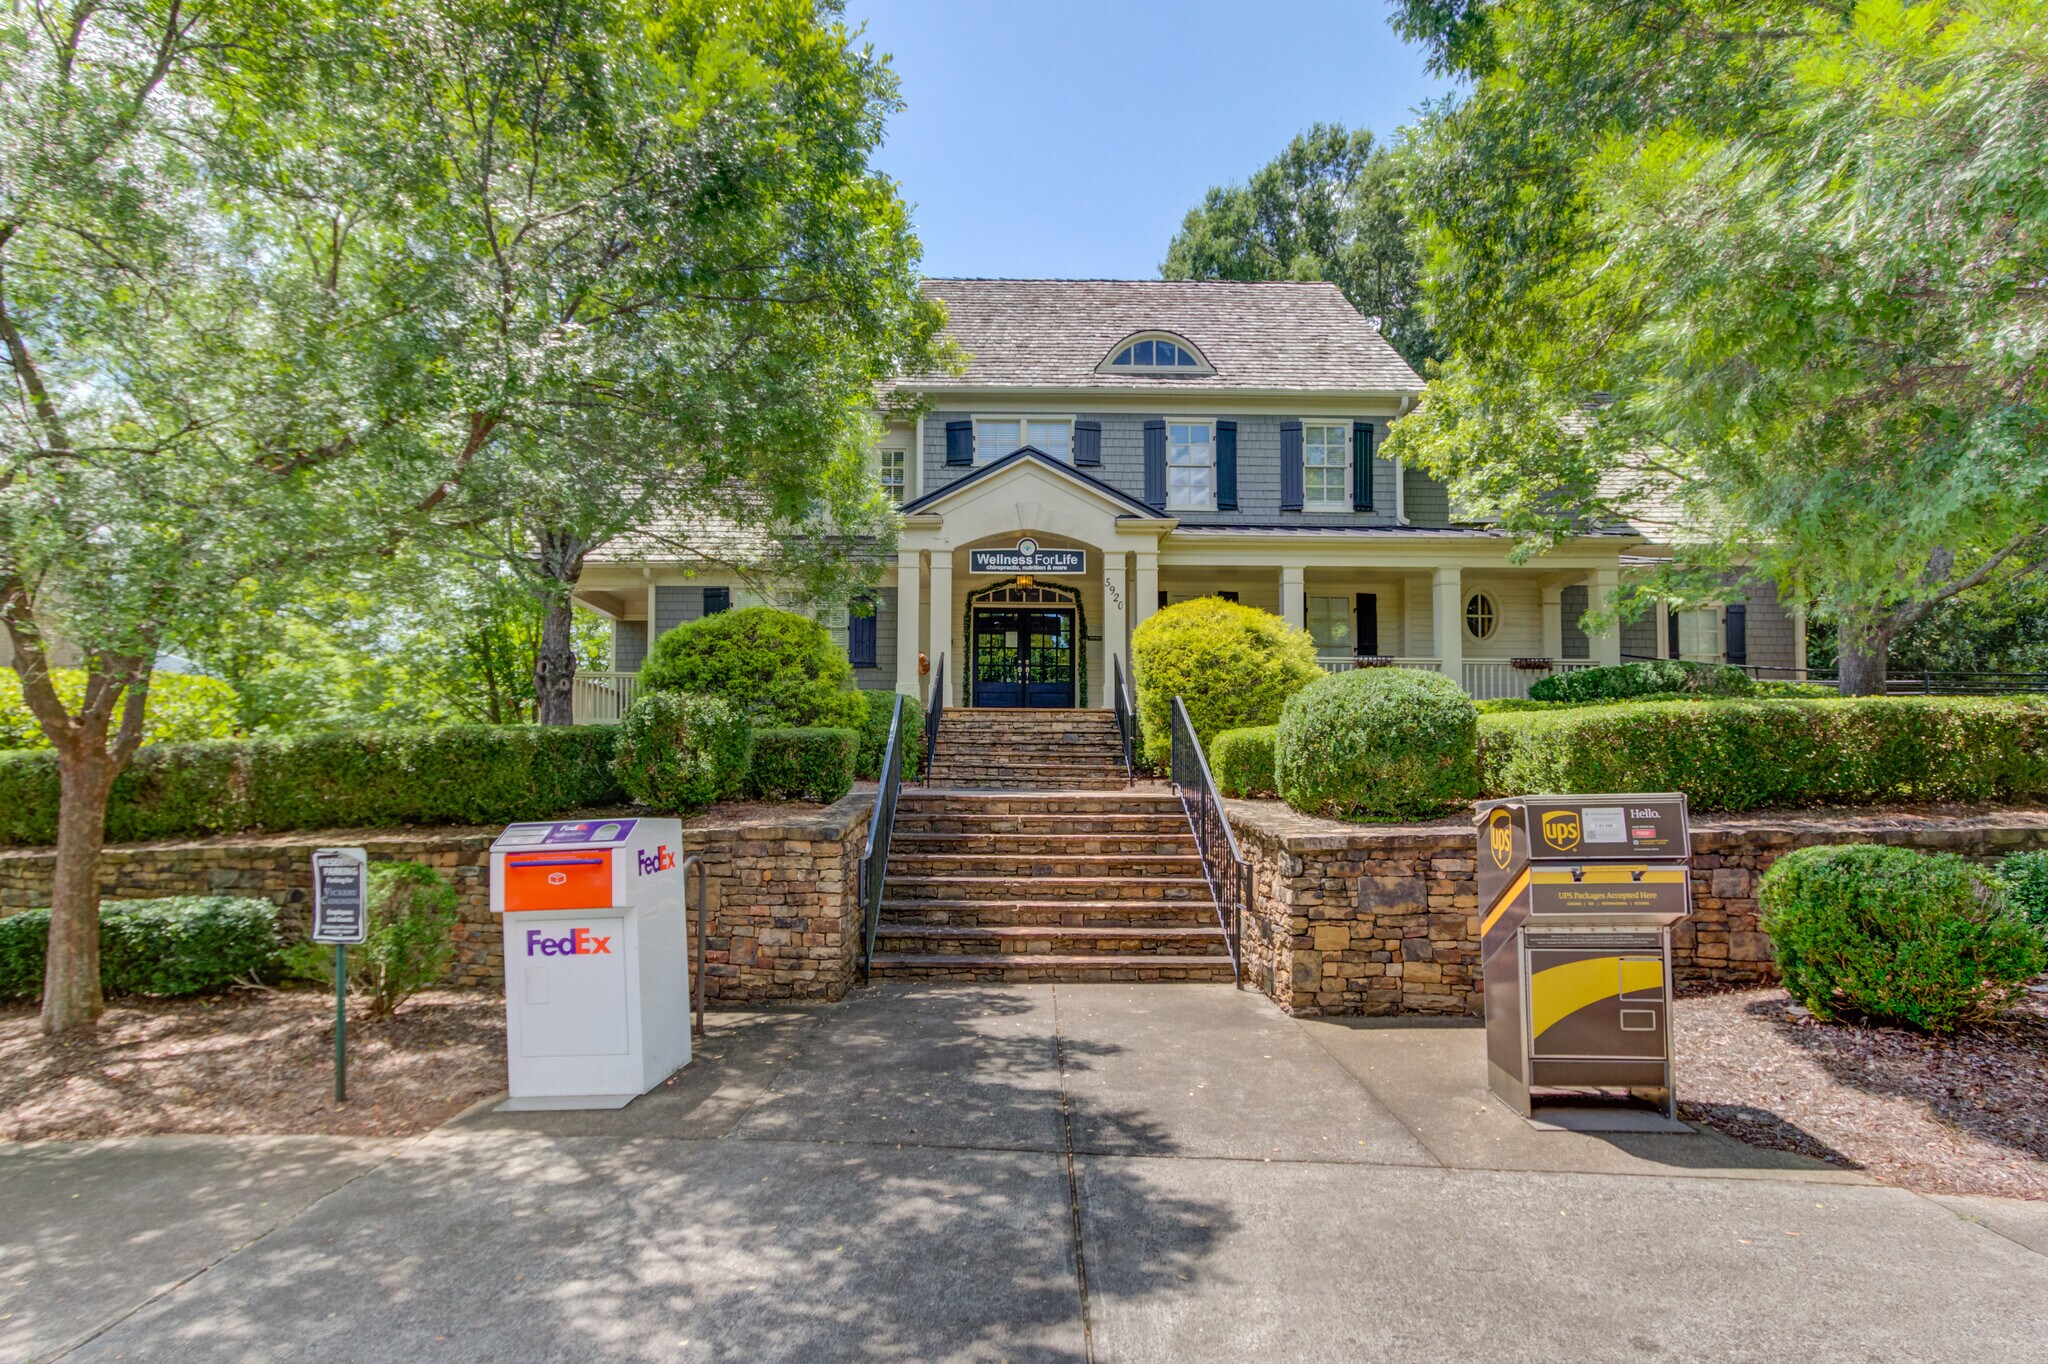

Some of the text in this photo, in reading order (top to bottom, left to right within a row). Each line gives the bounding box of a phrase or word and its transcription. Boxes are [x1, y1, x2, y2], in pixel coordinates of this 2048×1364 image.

[977, 553, 1033, 565] Wellness
[1104, 577, 1124, 611] 5920
[1630, 808, 1661, 819] Hello.
[1545, 822, 1578, 845] ups
[1492, 827, 1510, 860] ups
[638, 844, 676, 877] FedEx
[323, 868, 358, 876] PARKING
[323, 888, 358, 896] VICKERY
[1574, 892, 1606, 901] Packages
[1607, 892, 1640, 900] Accepted
[526, 928, 612, 957] FedEx
